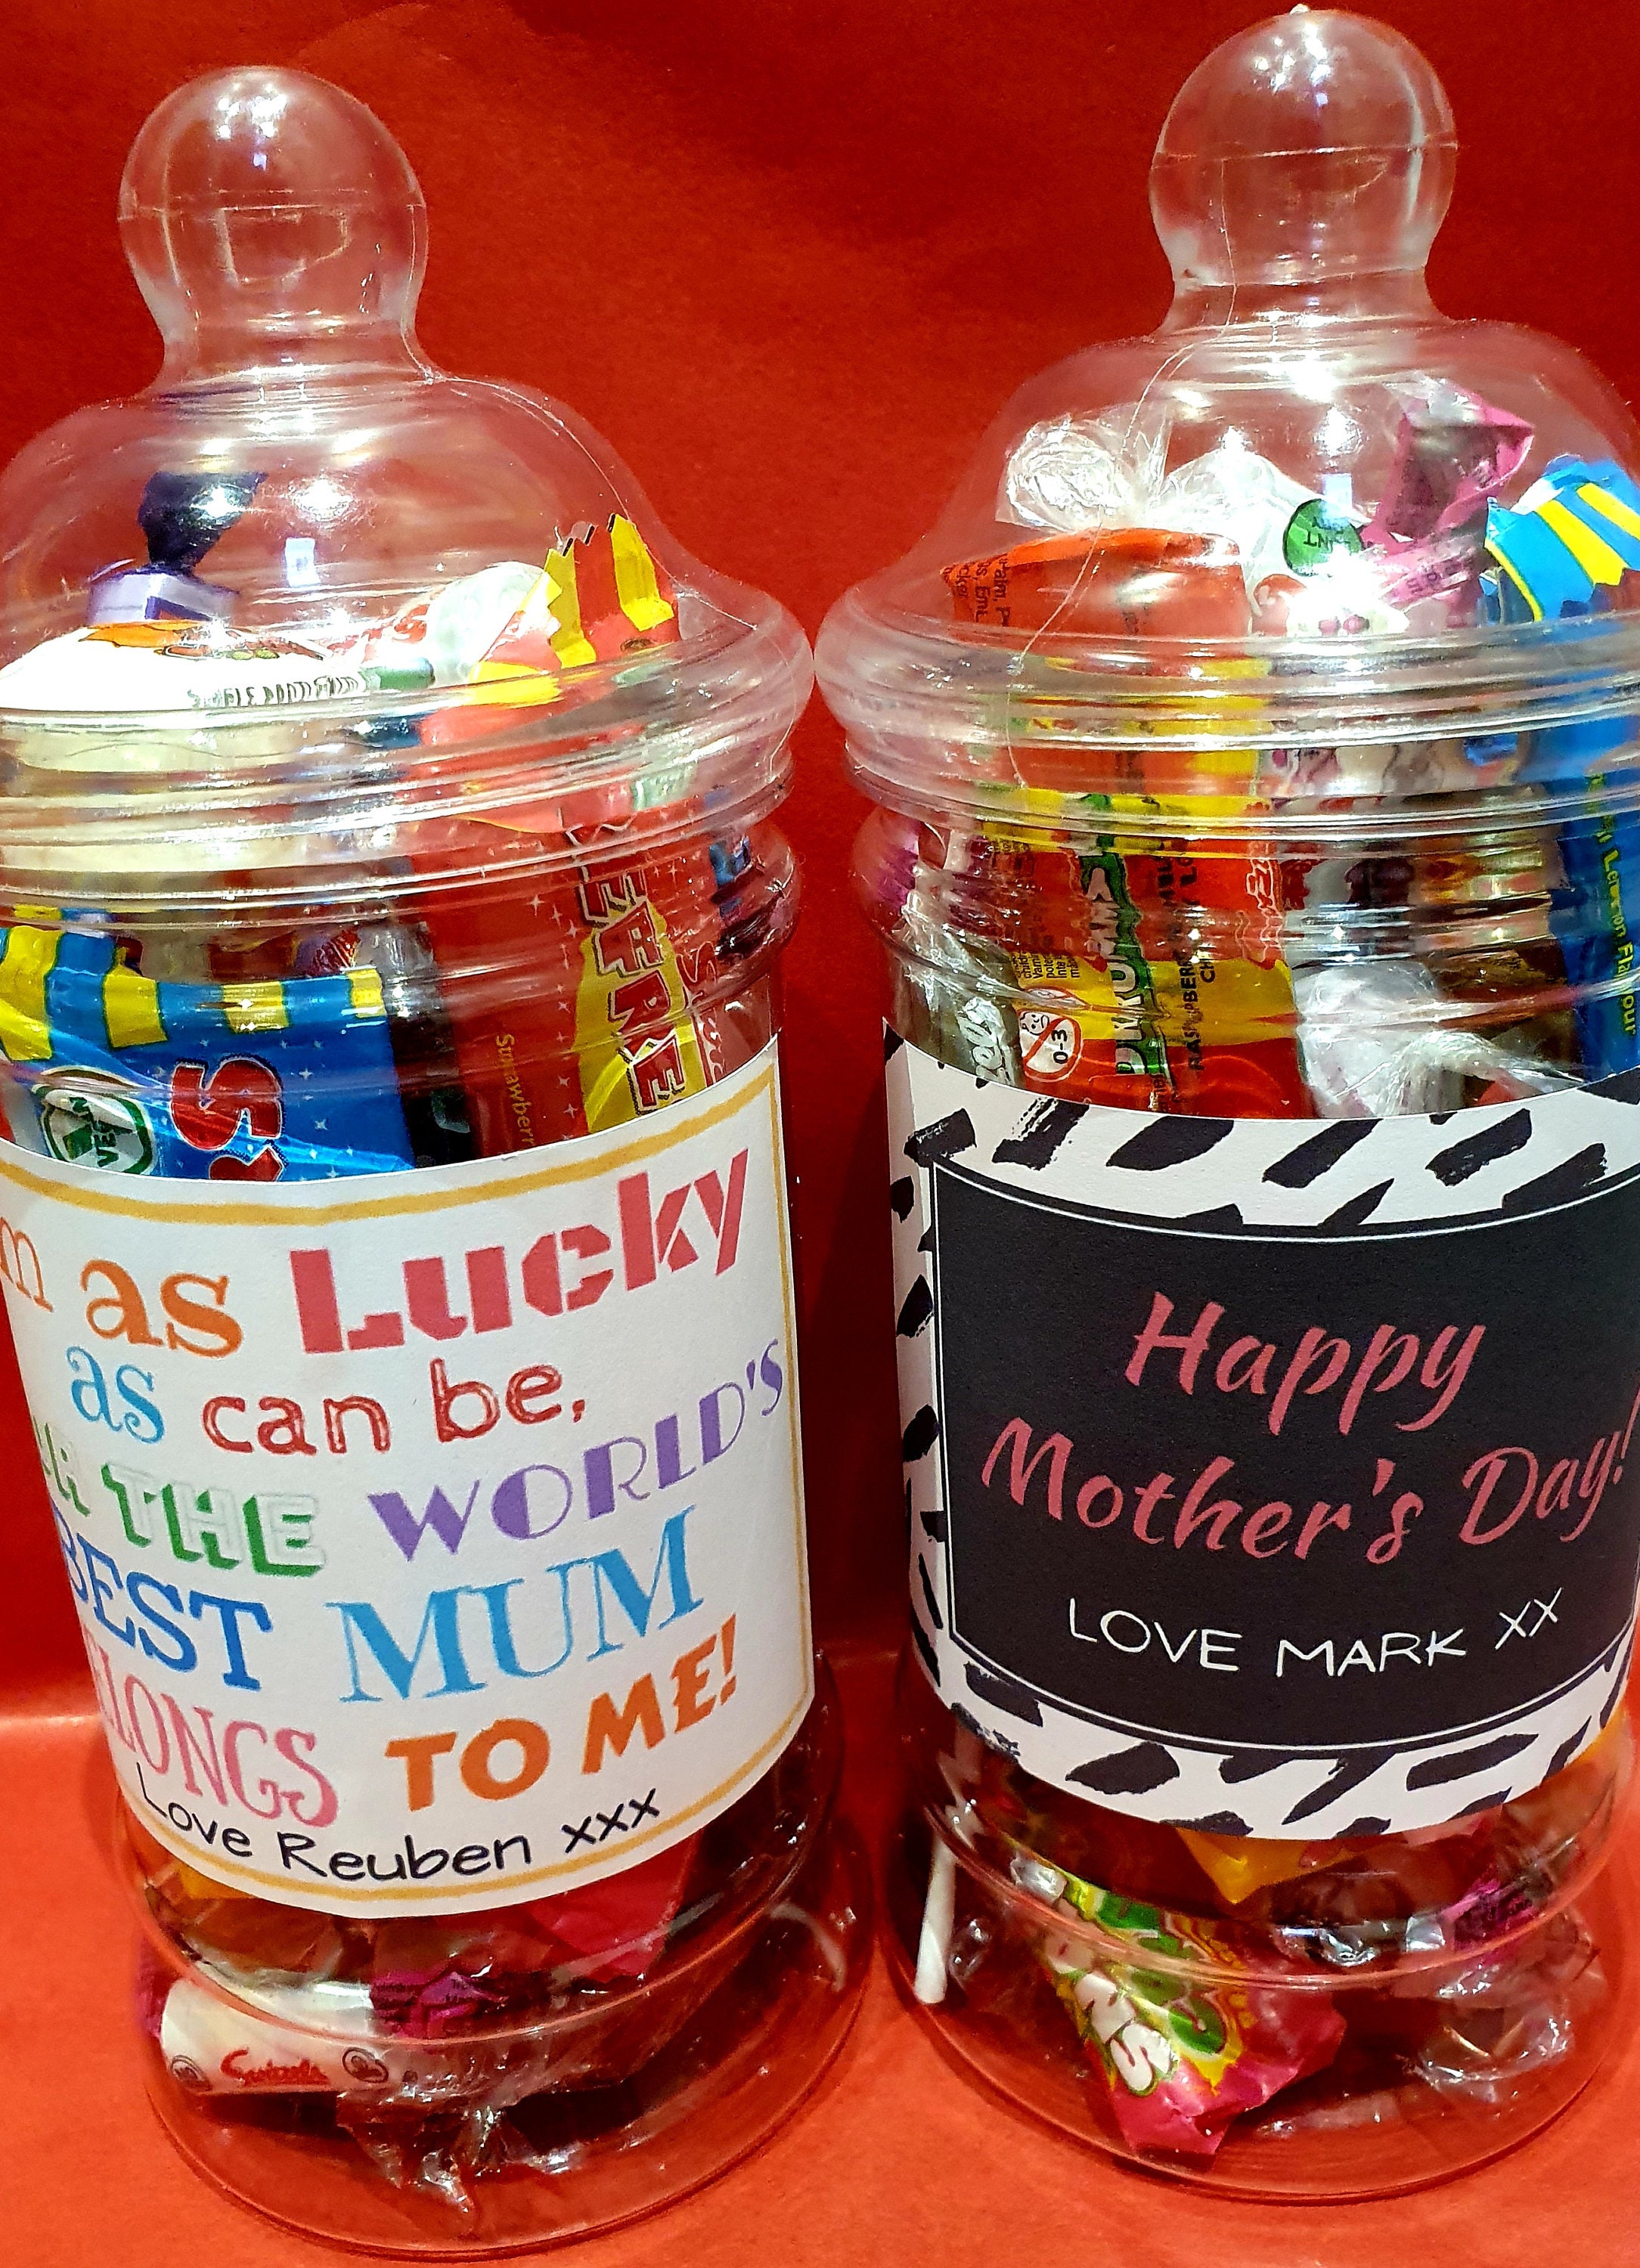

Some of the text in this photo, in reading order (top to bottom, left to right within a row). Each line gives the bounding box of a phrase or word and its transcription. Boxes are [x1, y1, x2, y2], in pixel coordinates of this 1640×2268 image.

[1050, 1029, 1068, 1064] 0-3
[80, 1259, 243, 1358] as
[289, 1148, 749, 1355] Lucky
[67, 1346, 585, 1455] as can be,
[1124, 1291, 1486, 1436] Happy
[101, 1461, 326, 1578] THE
[367, 1338, 783, 1563] WORLD'S
[982, 1382, 1640, 1565] Mother's Day!
[50, 1495, 704, 1703] BEST MUM
[1068, 1587, 1564, 1678] LOVE MARK XX
[385, 1718, 550, 1812] TO
[581, 1613, 736, 1775] ME!
[136, 1762, 253, 1857] Love
[277, 1832, 532, 1881] Reuben
